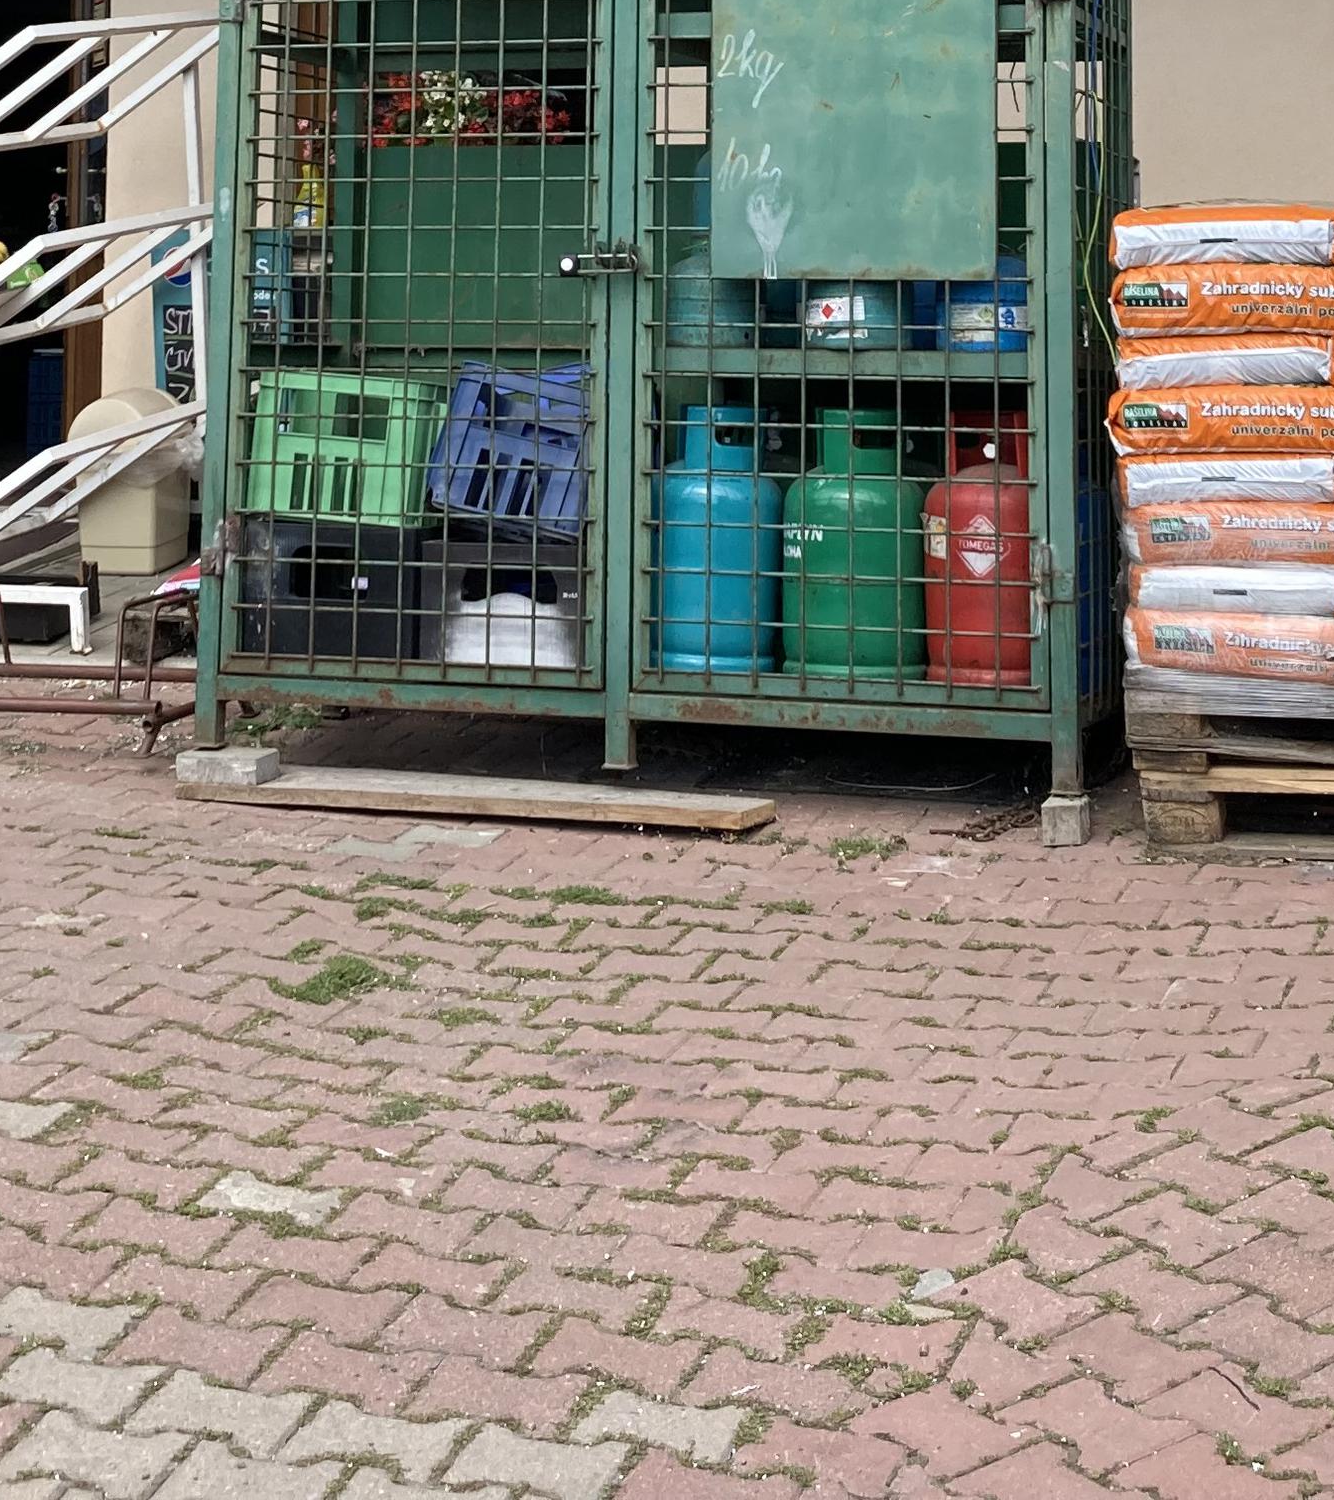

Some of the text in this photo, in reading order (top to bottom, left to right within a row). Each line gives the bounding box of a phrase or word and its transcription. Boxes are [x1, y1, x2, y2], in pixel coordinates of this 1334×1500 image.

[1201, 281, 1305, 299] Zahradnický
[1231, 302, 1312, 316] univerzální
[1201, 402, 1306, 420] Zahradnický
[1221, 514, 1322, 533] Zahradnický
